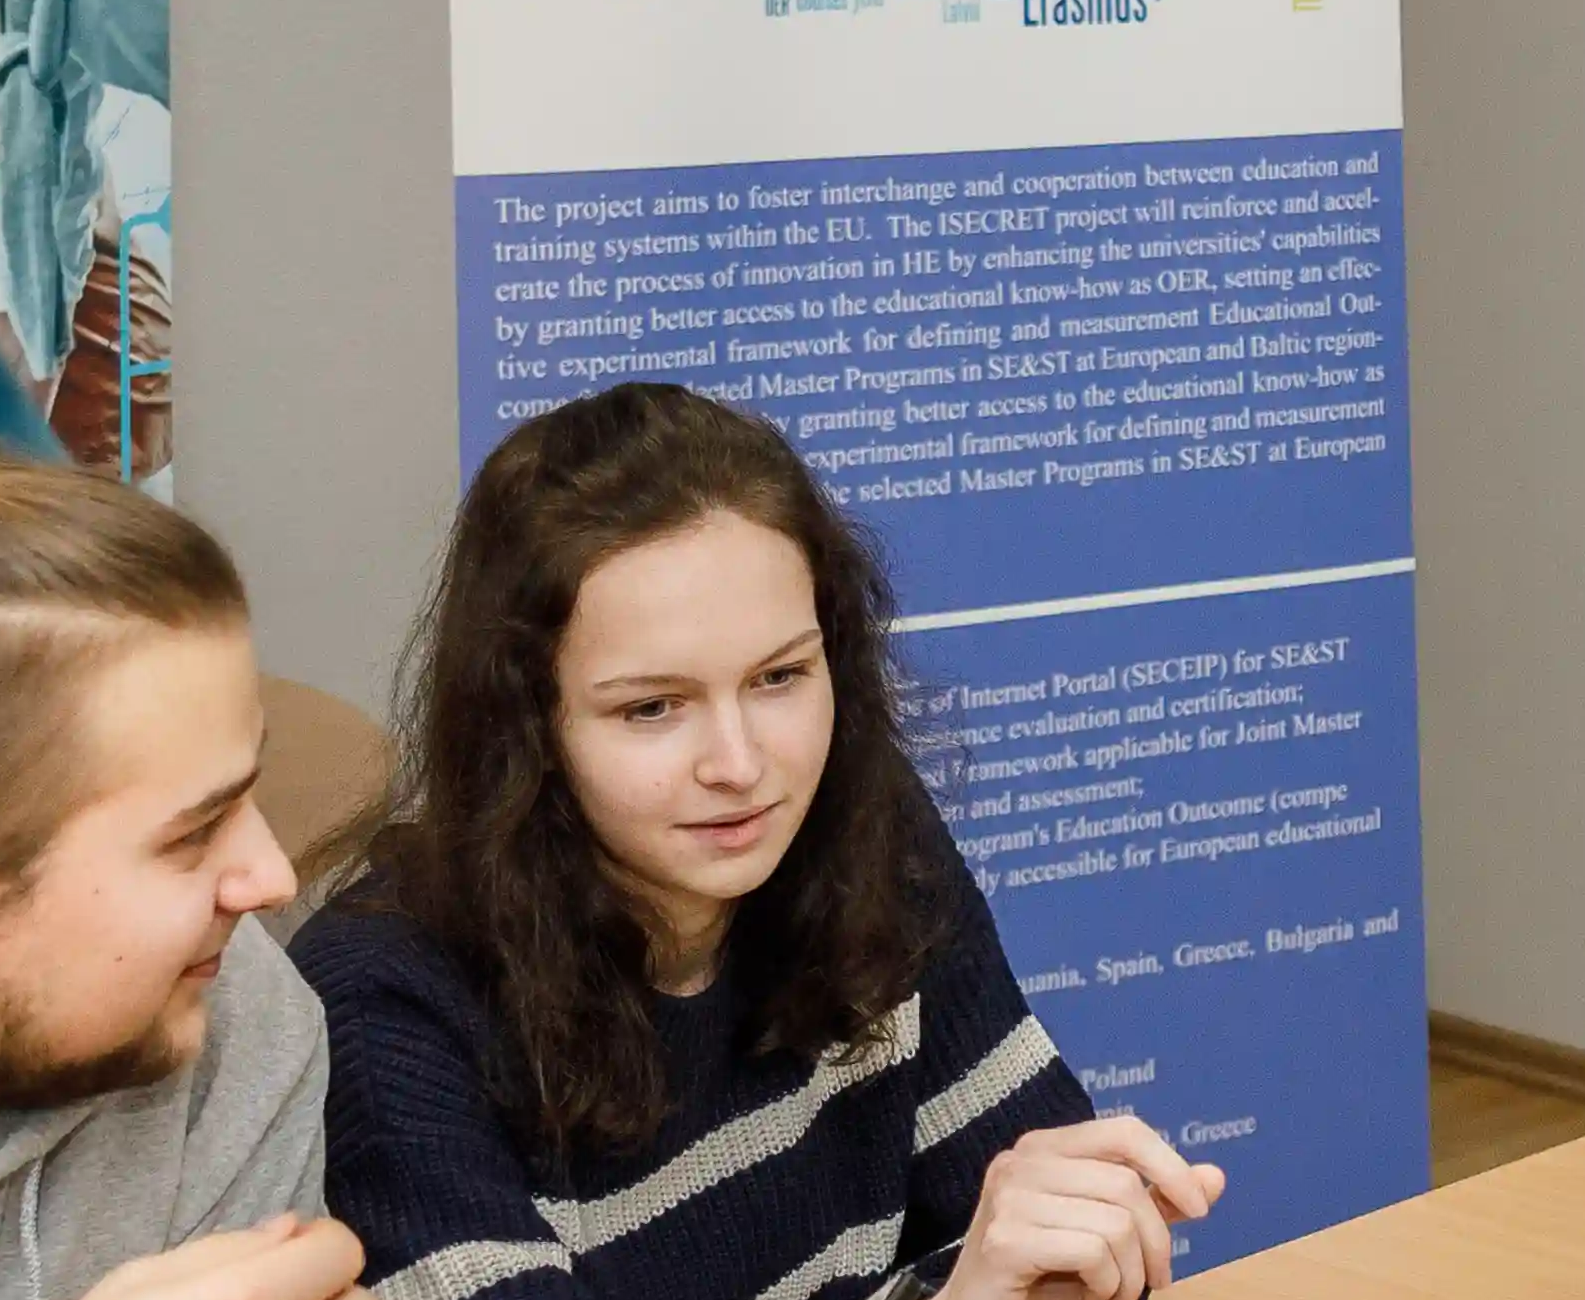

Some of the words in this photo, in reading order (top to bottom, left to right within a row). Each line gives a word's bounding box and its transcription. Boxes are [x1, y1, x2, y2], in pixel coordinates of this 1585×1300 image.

[494, 196, 545, 224] The
[556, 193, 644, 228] project
[653, 190, 709, 216] aims
[717, 191, 739, 212] to
[748, 185, 812, 209] foster
[820, 176, 956, 206] interchange
[963, 171, 1004, 197] and
[1012, 165, 1136, 199] cooperation
[1144, 164, 1233, 187] between
[1241, 154, 1338, 182] education
[1344, 150, 1378, 174] and
